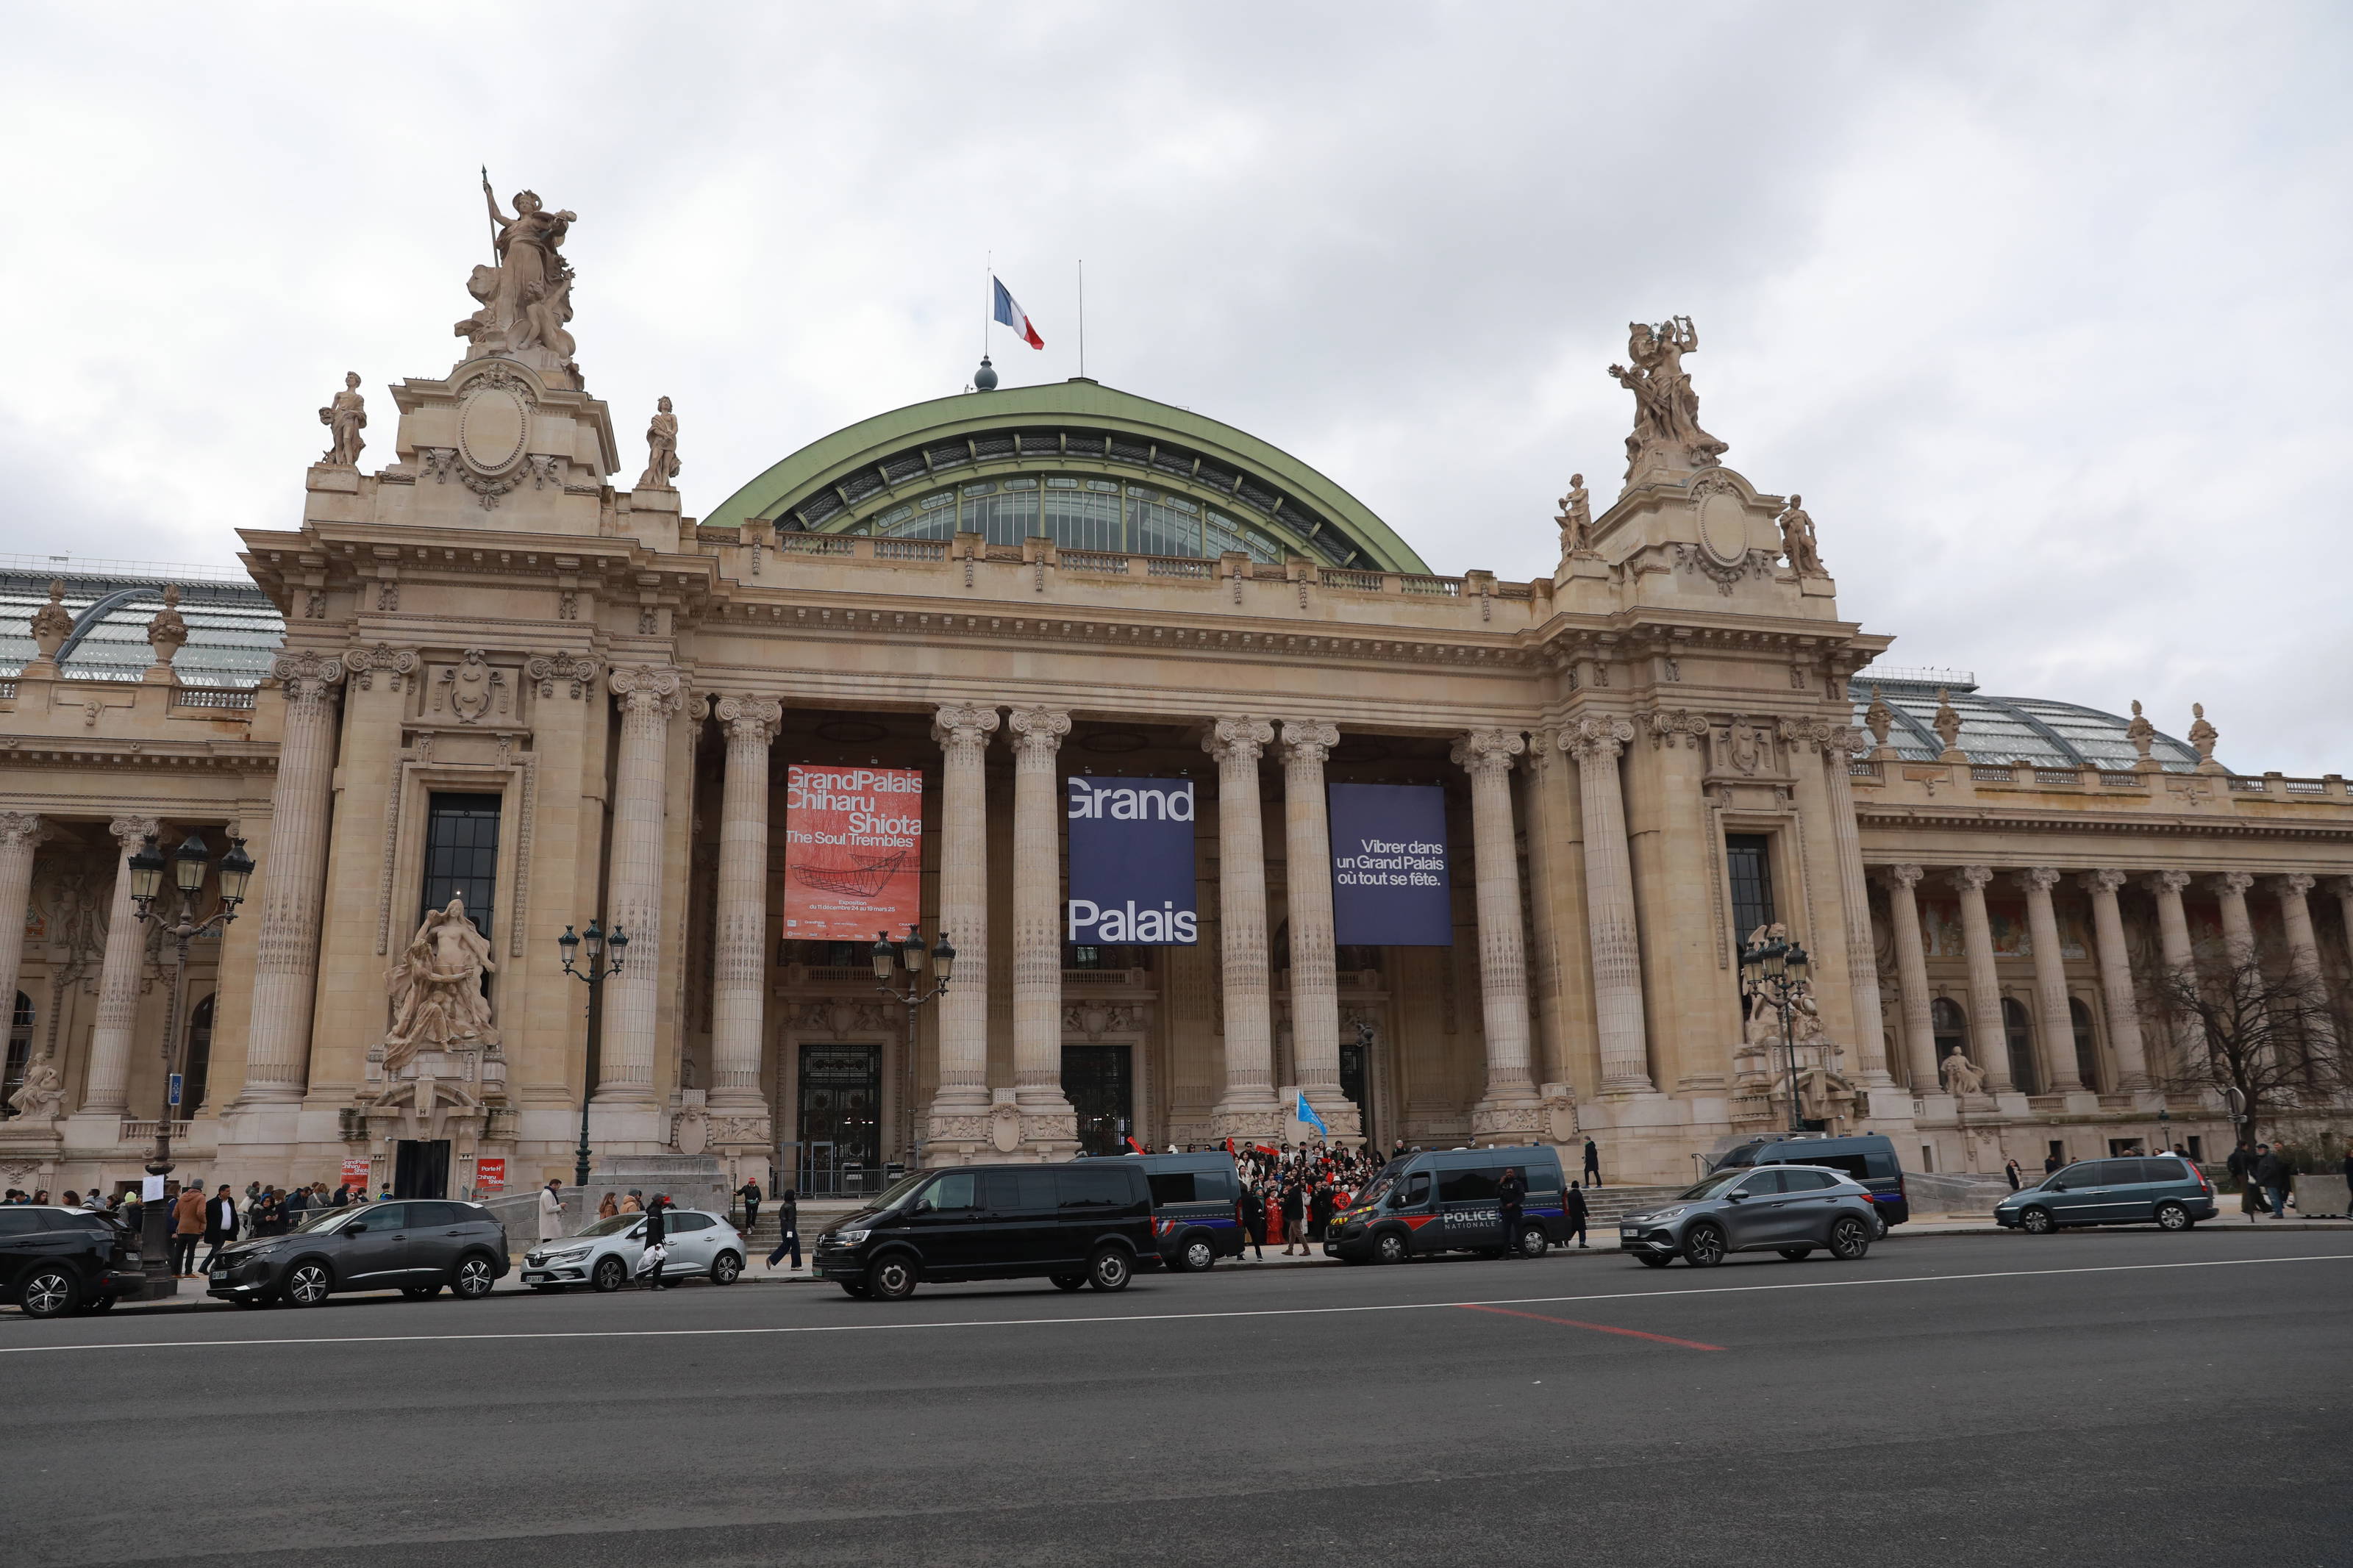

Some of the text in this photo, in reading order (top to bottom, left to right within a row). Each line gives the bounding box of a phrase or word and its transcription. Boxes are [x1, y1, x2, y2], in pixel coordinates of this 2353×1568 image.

[787, 787, 875, 812] Chiharu
[1068, 777, 1194, 822] Grand
[848, 812, 921, 835] Shiota
[786, 830, 914, 848] The Soul Trembles
[1361, 839, 1443, 854] Vibrer dans
[1337, 855, 1444, 870] un Grand Palais
[1338, 870, 1440, 886] où tout se fête.
[1068, 899, 1197, 942] Palais
[1443, 1210, 1496, 1223] POLICE
[1444, 1221, 1495, 1230] NATIONALE
